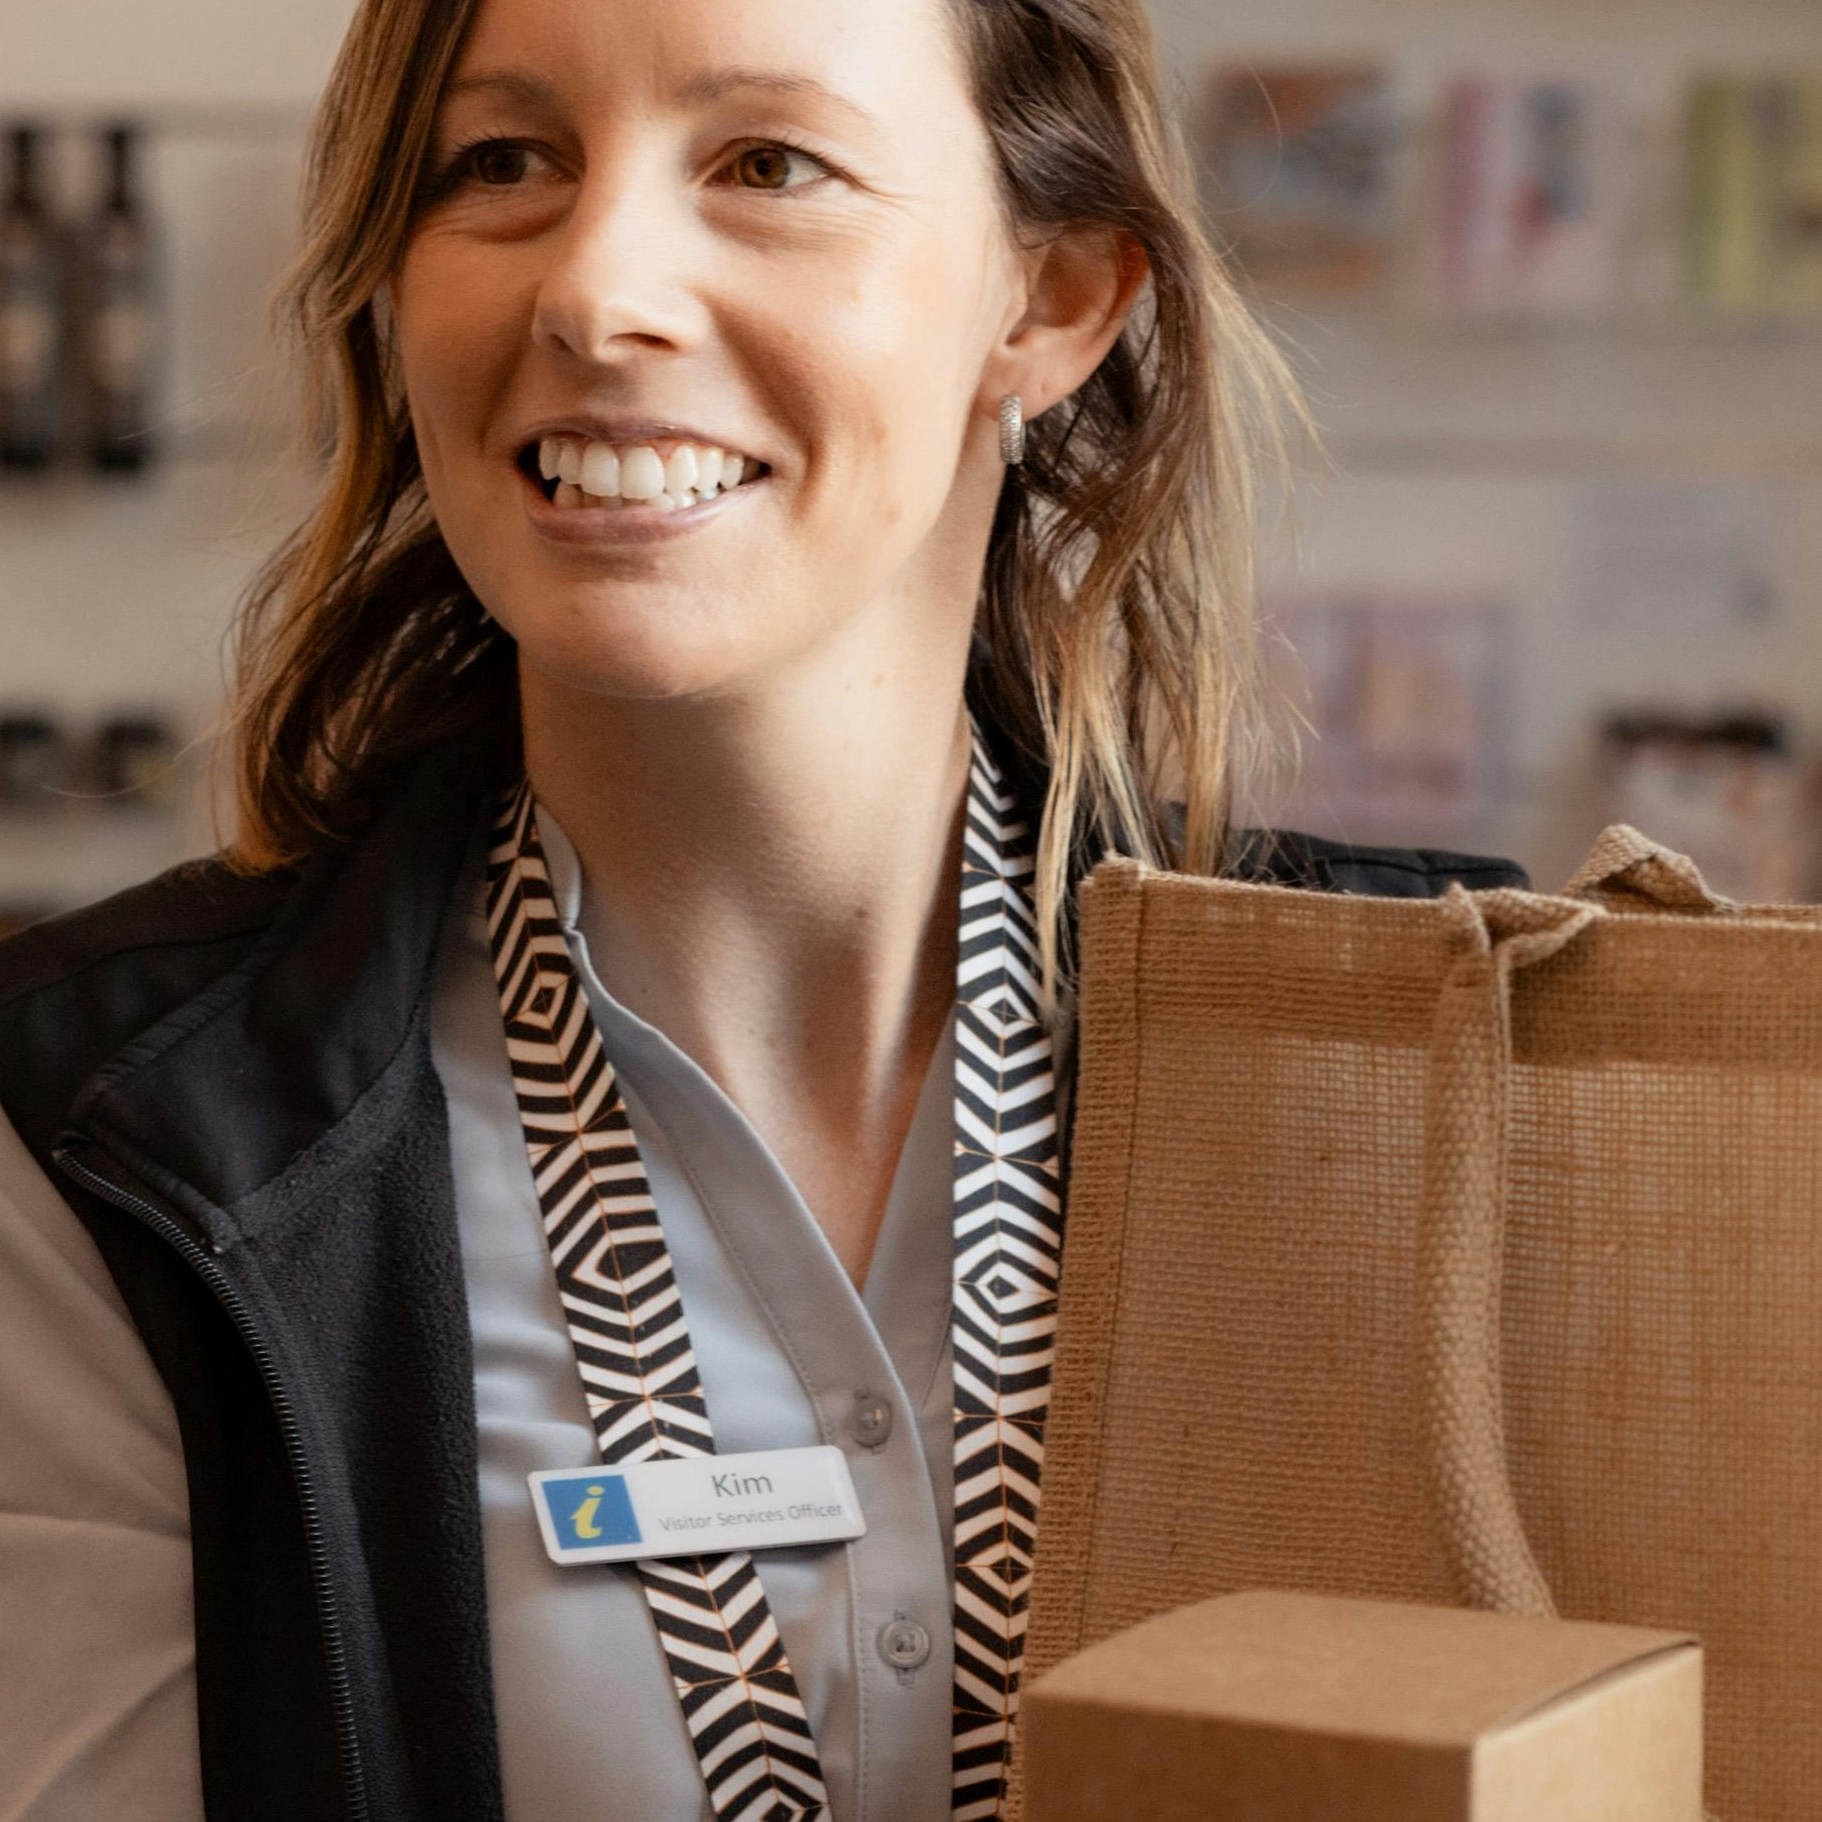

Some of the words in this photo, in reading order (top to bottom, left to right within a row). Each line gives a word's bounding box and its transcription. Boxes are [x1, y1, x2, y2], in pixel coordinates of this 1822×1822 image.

[711, 1472, 774, 1499] Kim
[657, 1515, 713, 1532] Visitor
[716, 1508, 786, 1528] Services
[787, 1503, 844, 1522] Officer
